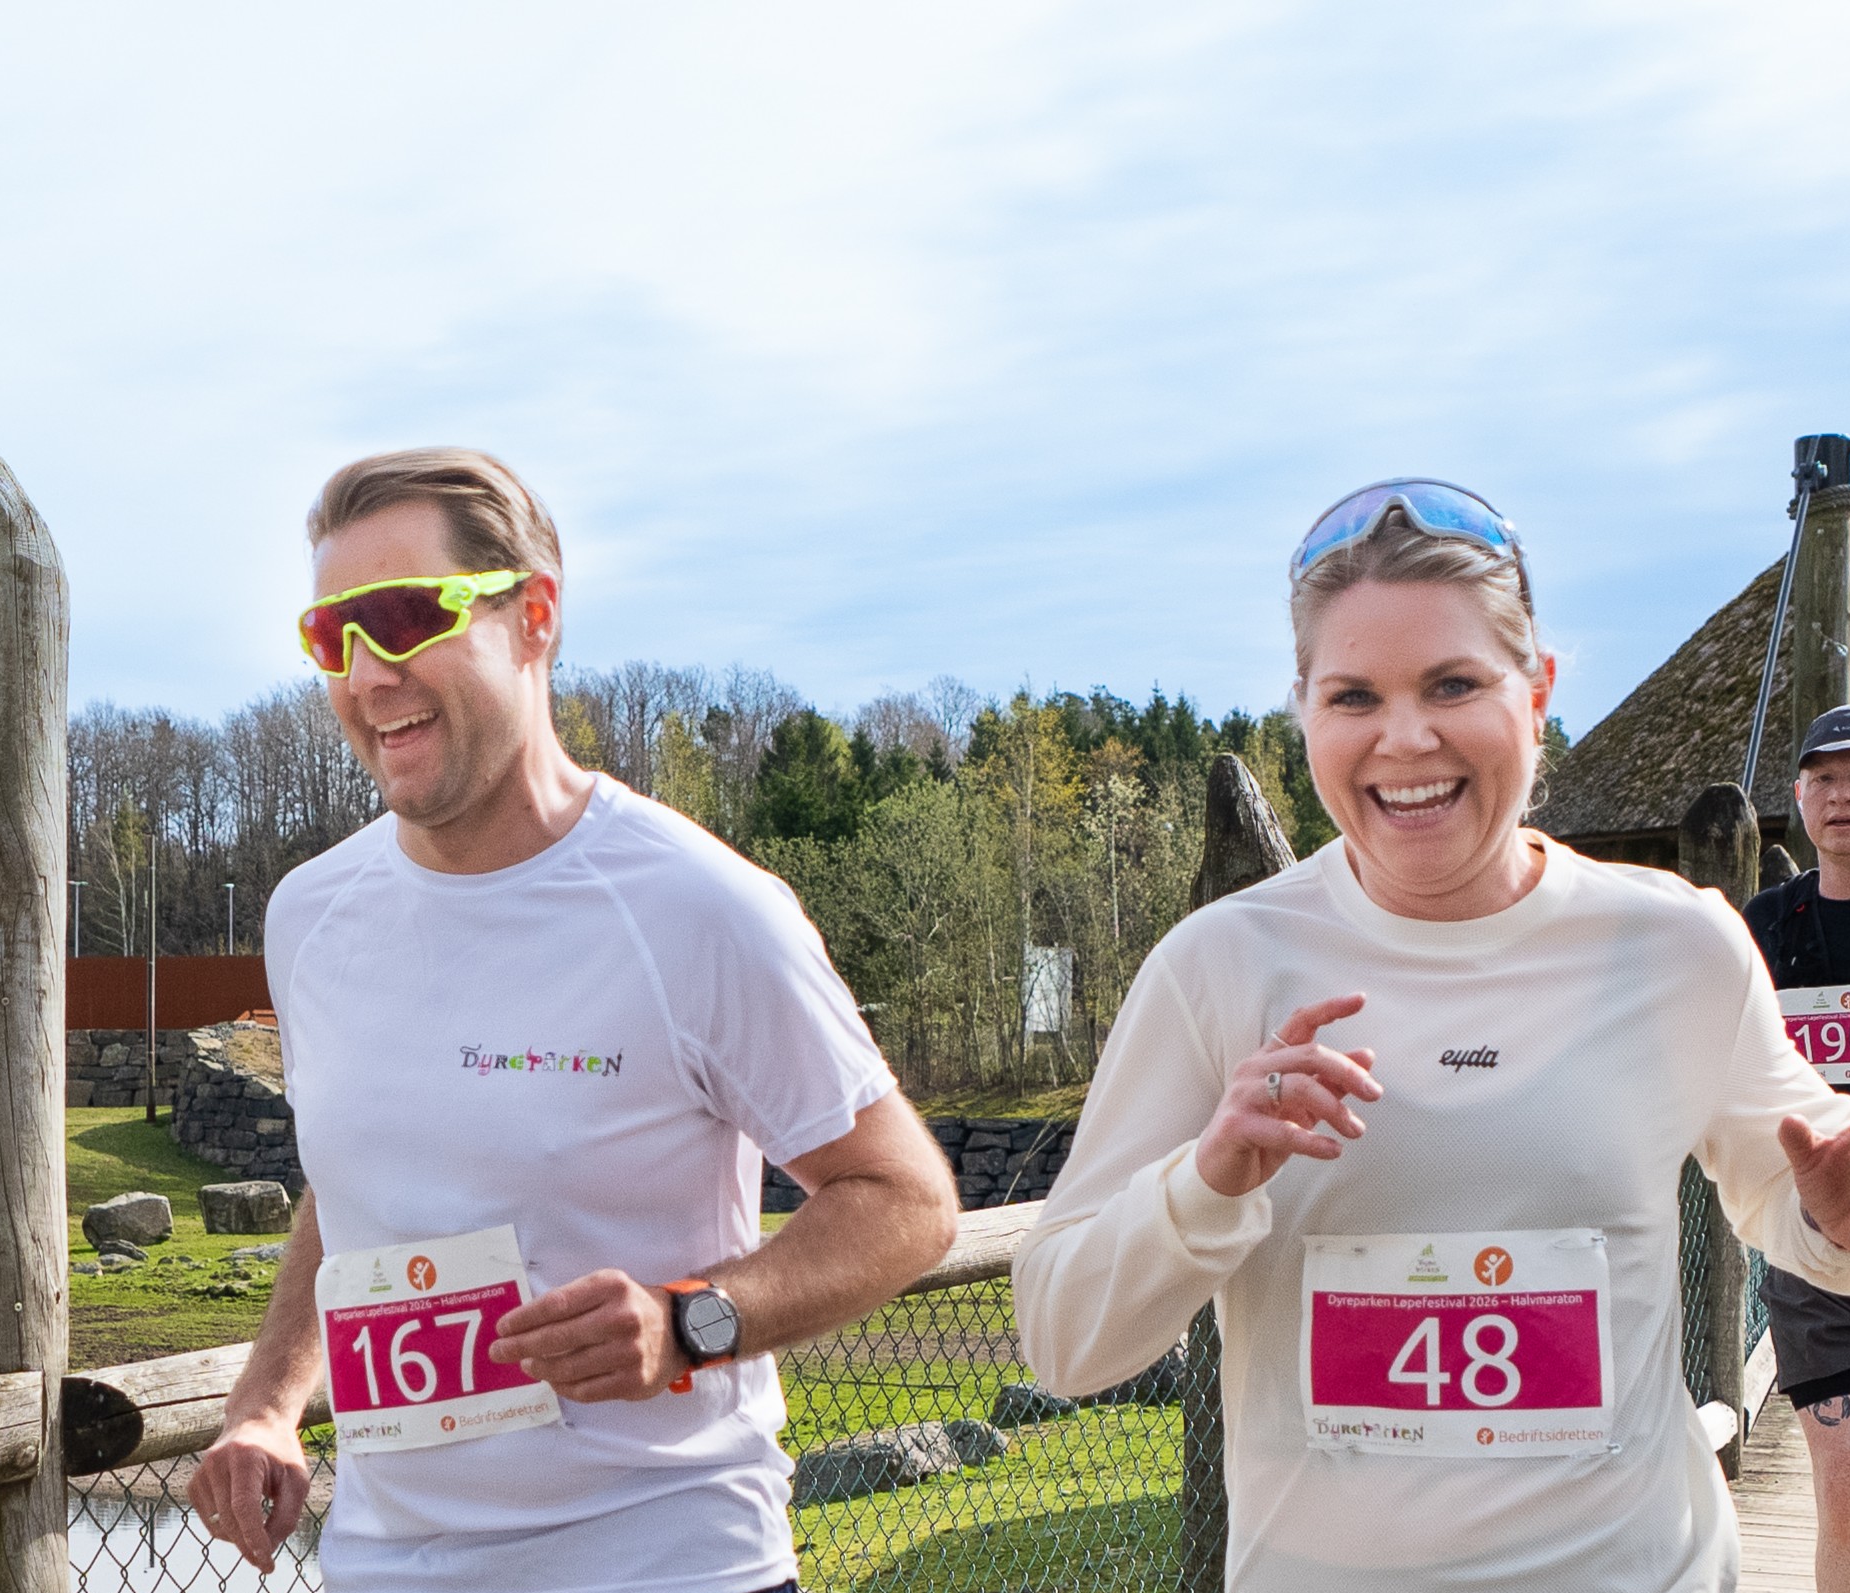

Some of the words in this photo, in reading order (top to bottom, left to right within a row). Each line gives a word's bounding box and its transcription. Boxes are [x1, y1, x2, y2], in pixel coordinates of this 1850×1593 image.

[1439, 1045, 1499, 1073] eyda
[409, 1301, 432, 1312] 2026
[441, 1286, 505, 1307] Halvmaraton
[1328, 1294, 1391, 1307] Dyreparken
[1393, 1294, 1466, 1309] Løpefestival
[1469, 1295, 1499, 1307] 2026
[1511, 1293, 1582, 1306] Halvmaraton
[353, 1309, 482, 1405] 167
[1388, 1314, 1521, 1406] 48
[459, 1400, 549, 1428] Bedriftsidretten
[1499, 1428, 1603, 1443] Bedriftsidretten
